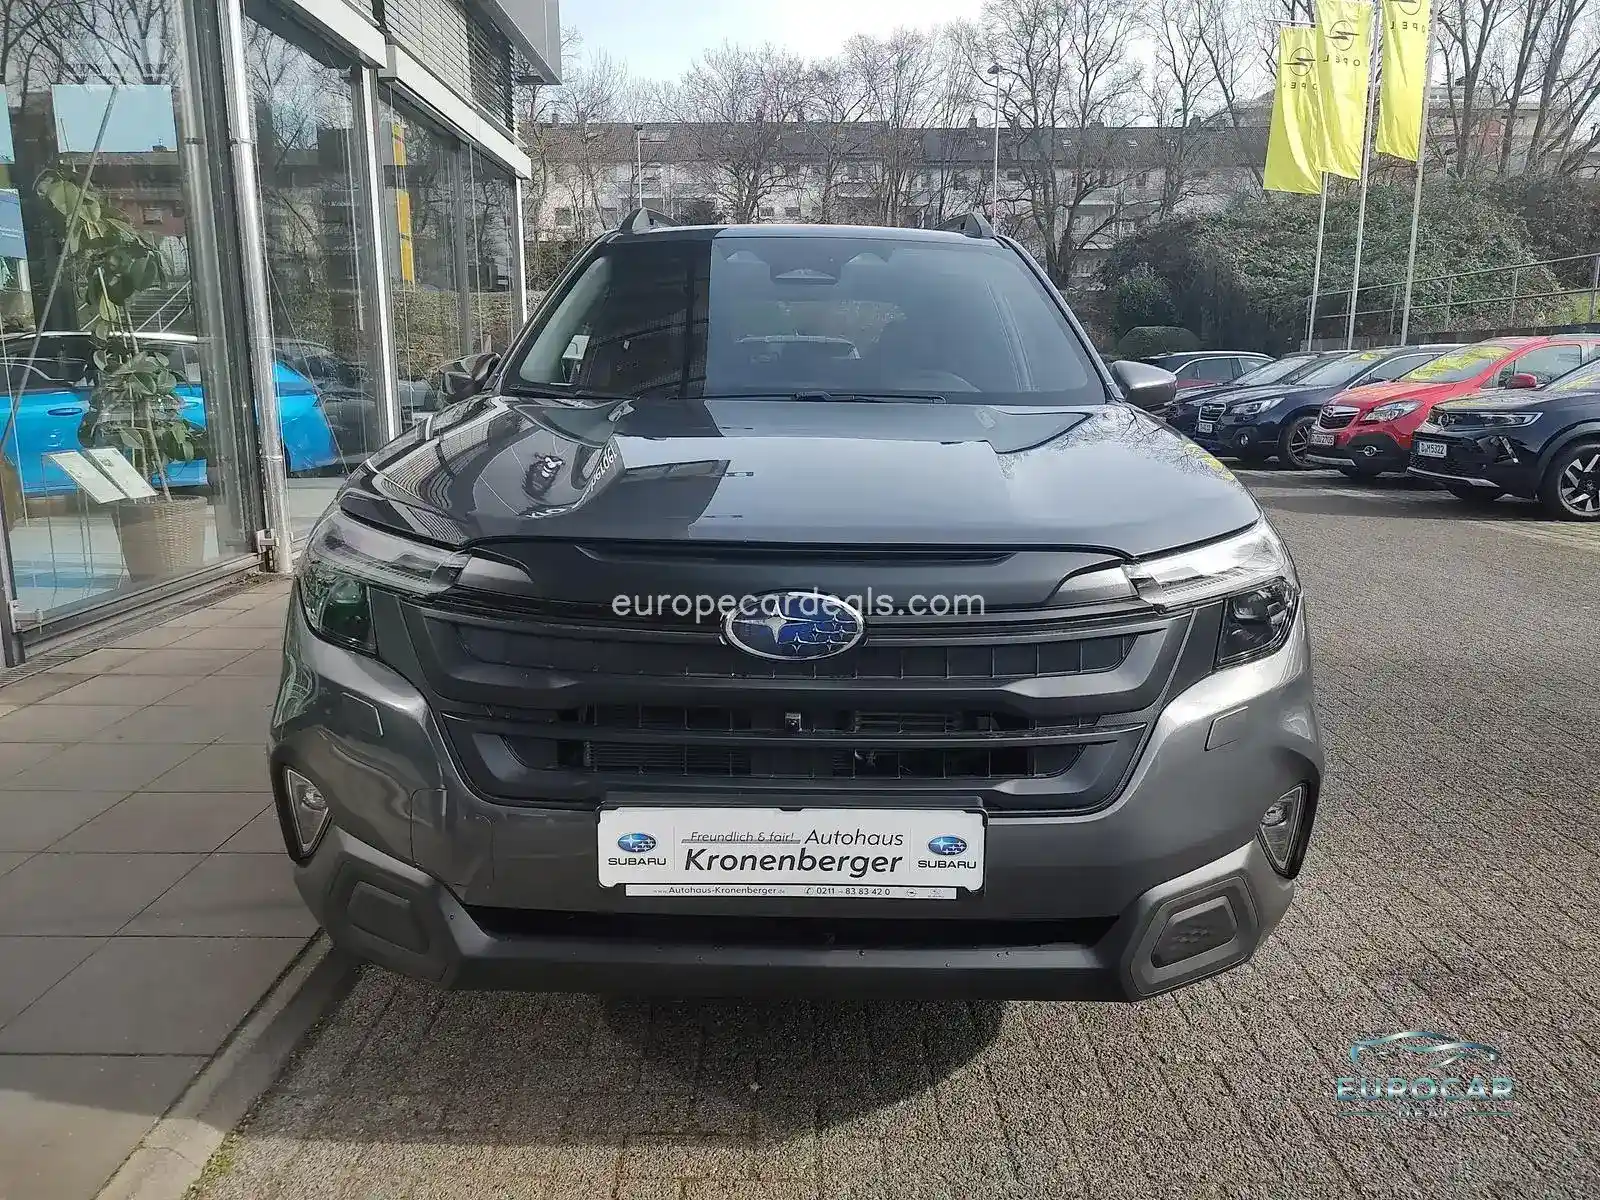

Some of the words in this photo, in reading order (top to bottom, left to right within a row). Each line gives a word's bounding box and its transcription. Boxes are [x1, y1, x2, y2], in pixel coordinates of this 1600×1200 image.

[690, 831, 753, 842] Freundlich
[757, 832, 766, 842] &
[769, 831, 794, 842] fair!
[804, 828, 904, 846] Autohaus
[608, 857, 667, 866] SUBARU
[684, 848, 904, 878] Kronenberger
[917, 859, 977, 869] SUBARU
[816, 887, 835, 895] 0211
[845, 887, 856, 895] 83
